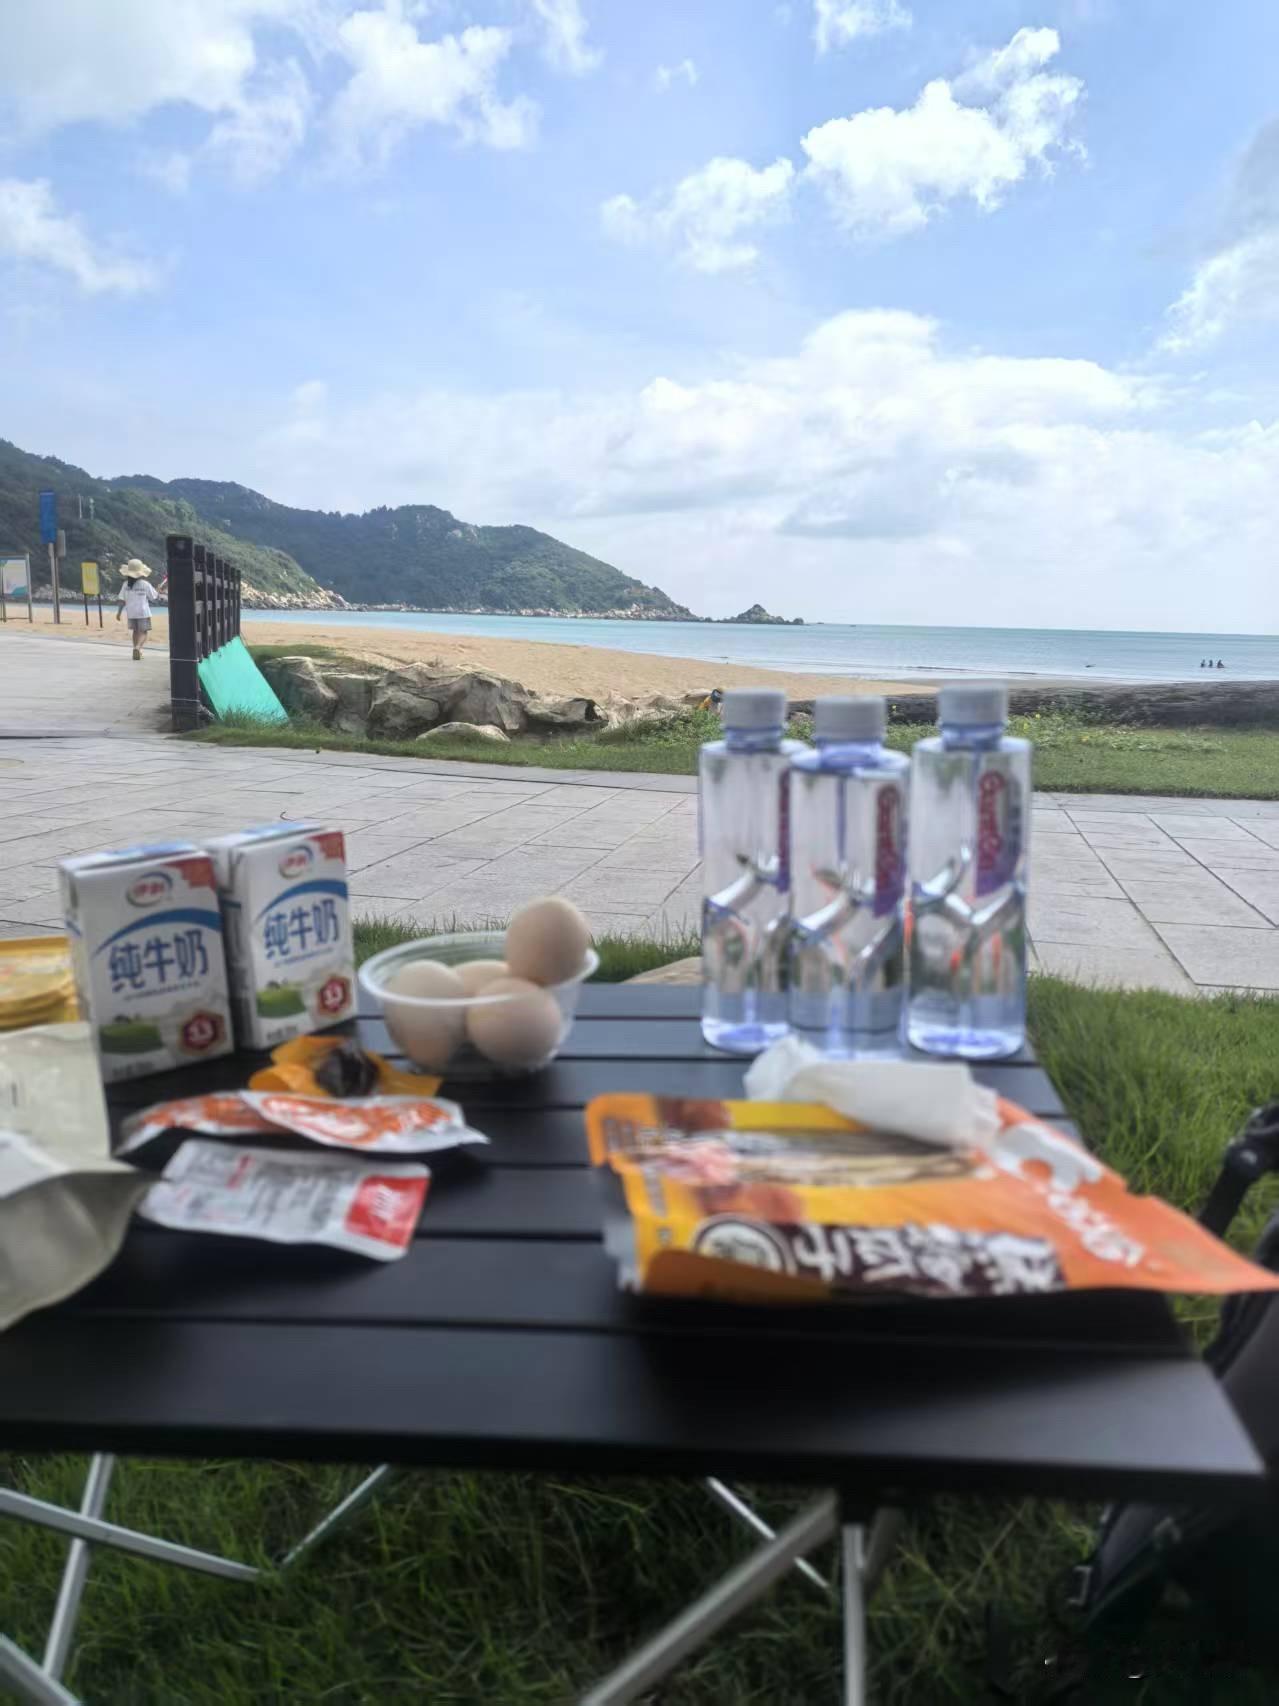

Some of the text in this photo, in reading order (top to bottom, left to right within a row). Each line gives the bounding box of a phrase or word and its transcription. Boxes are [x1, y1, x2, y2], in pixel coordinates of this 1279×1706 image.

[264, 899, 339, 960] 纯牛奶
[109, 929, 209, 993] 纯牛奶
